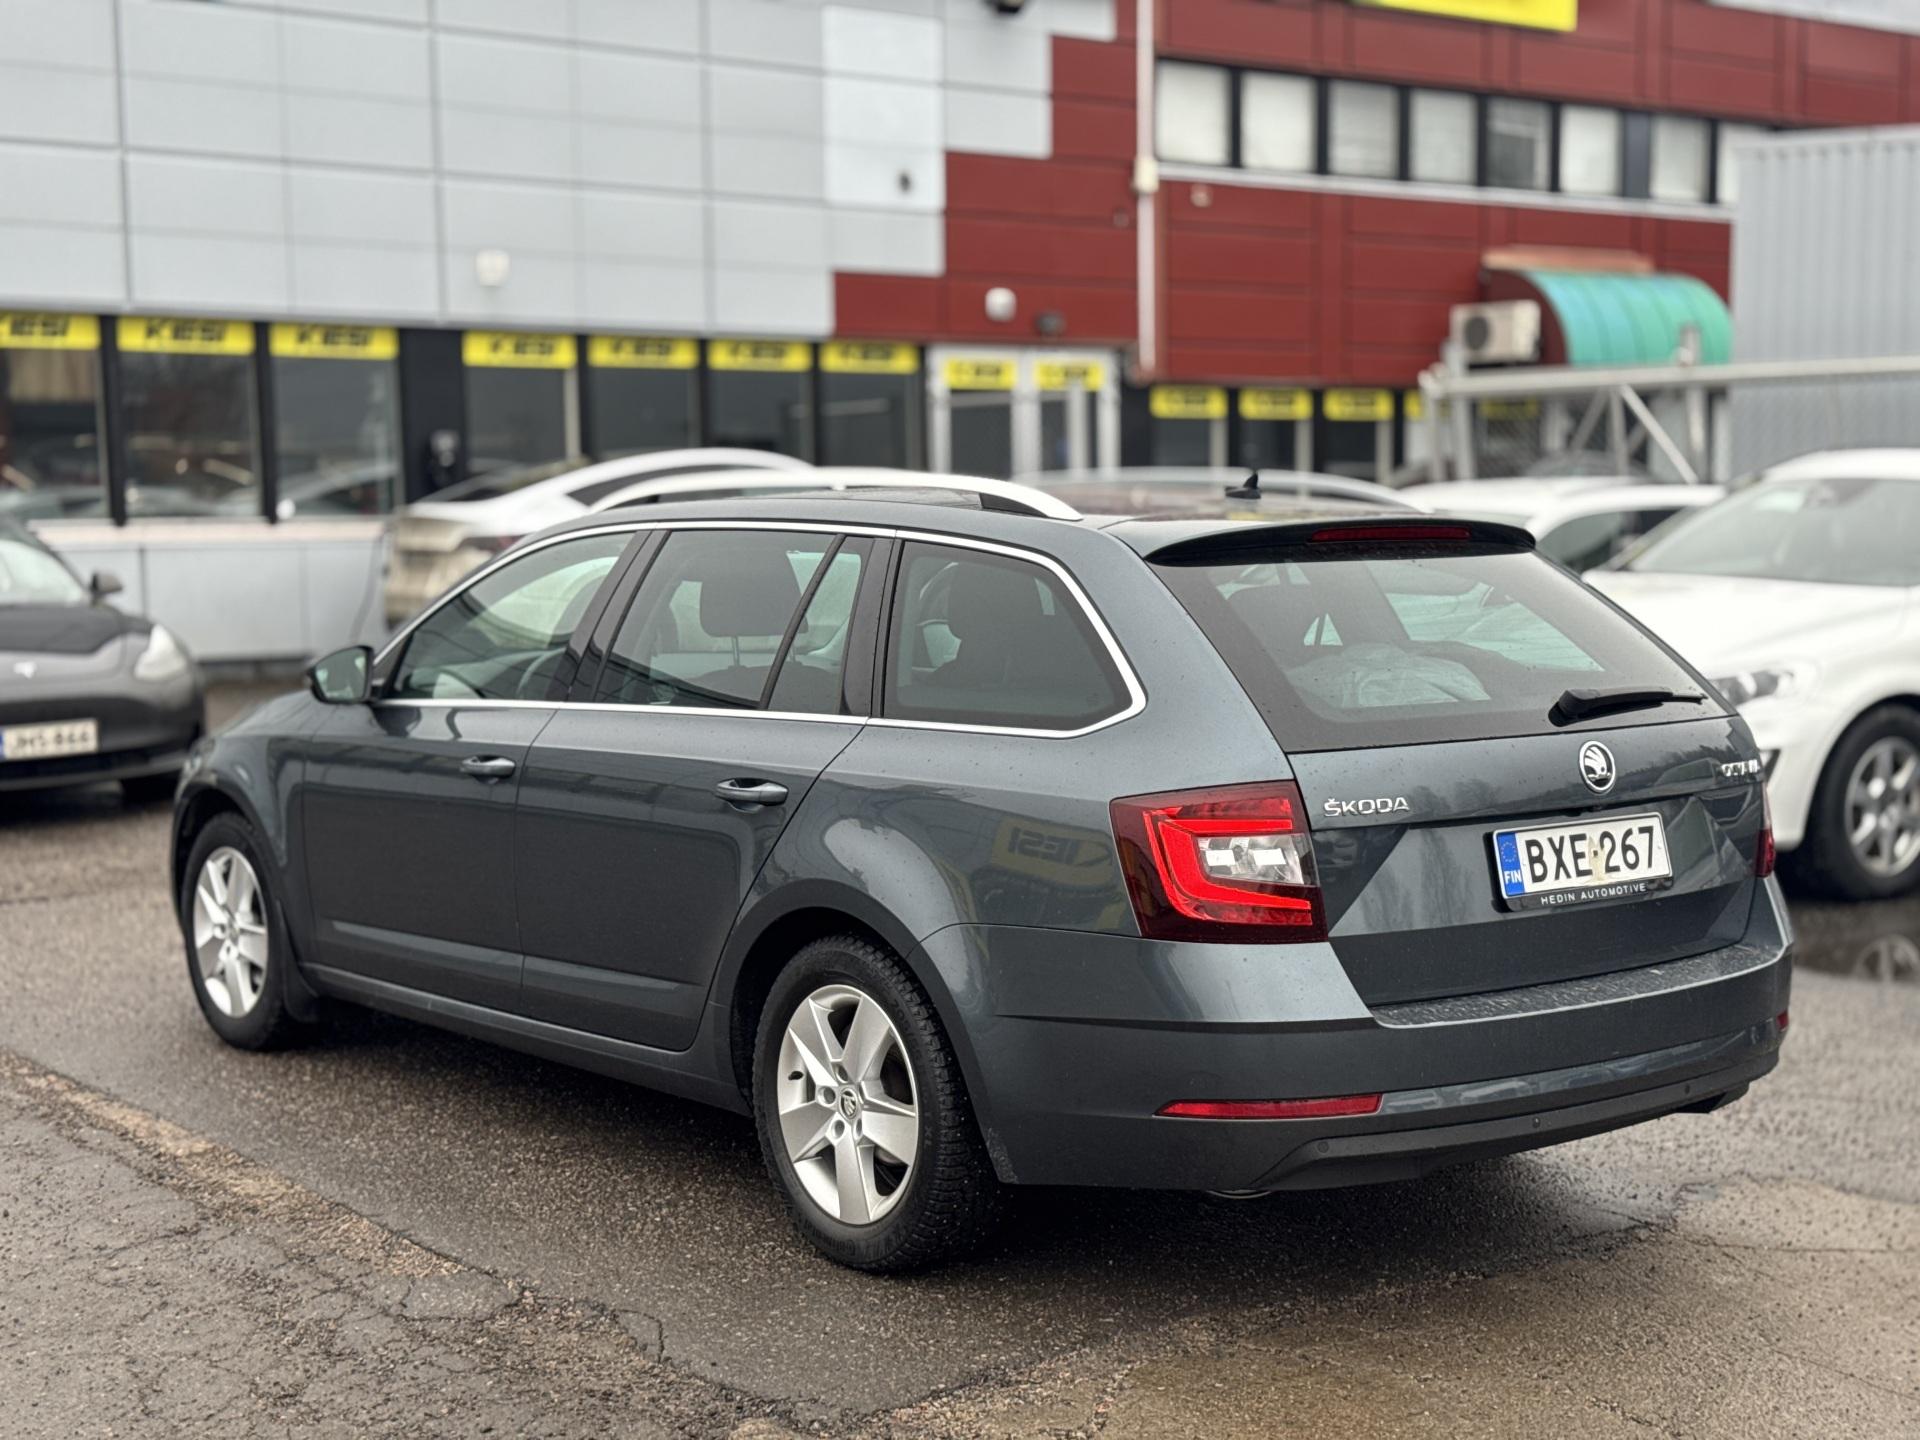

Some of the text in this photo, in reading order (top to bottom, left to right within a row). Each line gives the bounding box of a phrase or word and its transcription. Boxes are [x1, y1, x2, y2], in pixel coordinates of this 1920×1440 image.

[1323, 798, 1410, 817] ŠKODA
[1504, 869, 1522, 885] FIN
[1540, 882, 1647, 906] HEDIN AUTOMOTIVE
